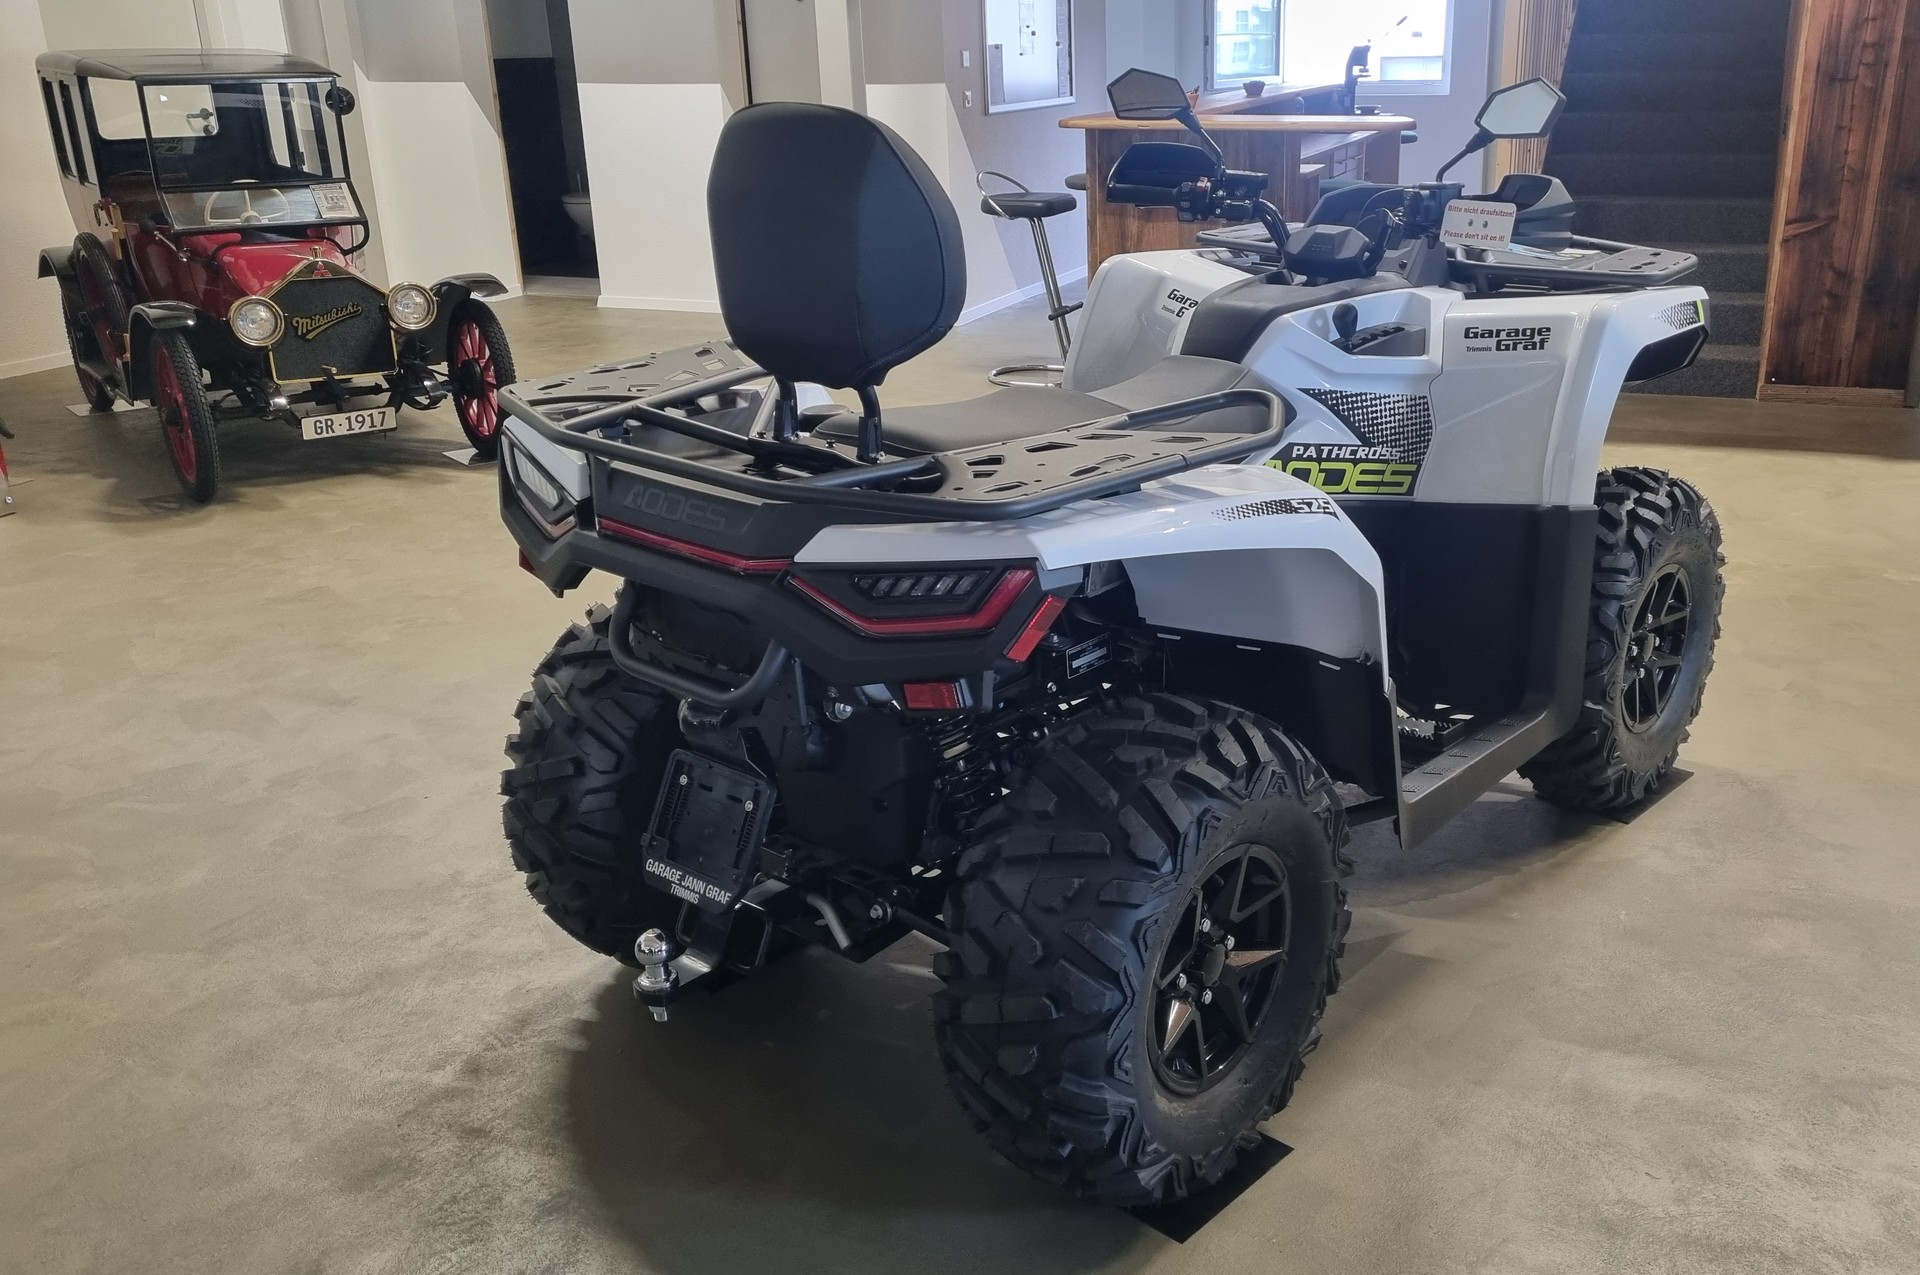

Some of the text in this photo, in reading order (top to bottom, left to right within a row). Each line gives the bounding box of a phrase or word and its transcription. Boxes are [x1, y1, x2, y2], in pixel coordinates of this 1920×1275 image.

[1448, 205, 1515, 218] Bitte nicht draufsitzen!
[1444, 230, 1464, 239] Please
[292, 302, 362, 337] Mitsubishi
[1464, 327, 1551, 340] Garage
[1495, 337, 1550, 351] Graf
[1292, 446, 1400, 460] PATHCROSS
[1294, 499, 1335, 513] 525
[645, 859, 732, 905] GARAGE JANN GRAF
[670, 883, 700, 904] TRIMMIS
